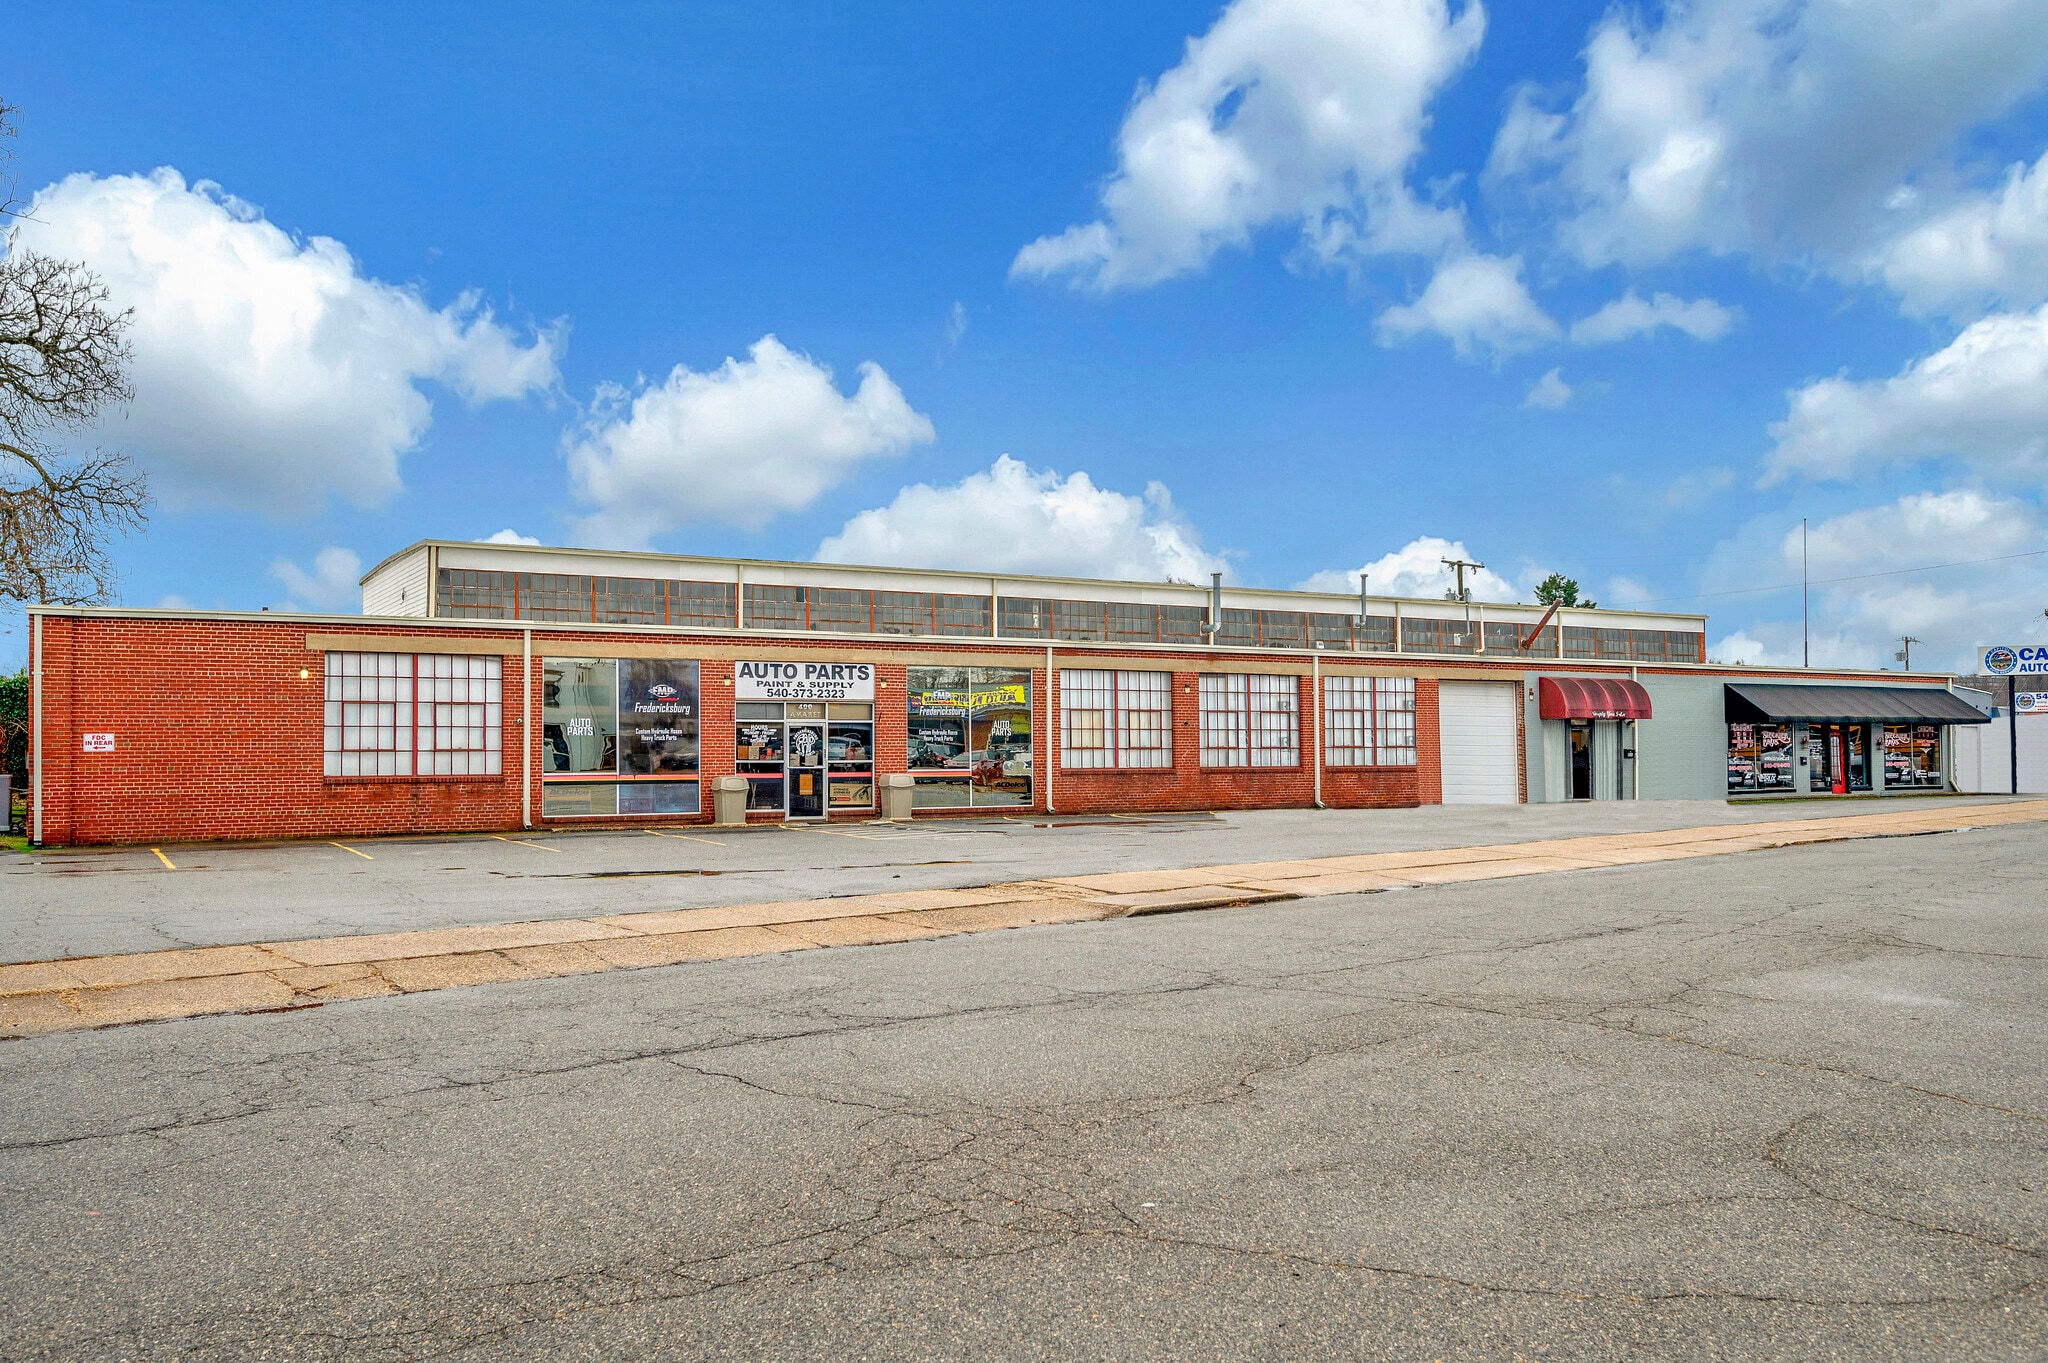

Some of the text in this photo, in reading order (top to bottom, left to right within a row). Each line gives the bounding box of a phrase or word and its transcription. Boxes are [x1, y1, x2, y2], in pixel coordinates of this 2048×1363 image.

[738, 662, 870, 681] AUTO PARTS
[756, 680, 792, 688] PAINT
[809, 681, 855, 689] SUPPLY
[766, 688, 845, 699] 540-373-2323
[634, 702, 691, 715] Fredericksburg
[919, 706, 966, 718] Fredericksburg
[569, 718, 591, 727] AUTO
[993, 720, 1010, 728] AUTO
[567, 727, 594, 736] PARTS
[991, 727, 1012, 736] PARTS
